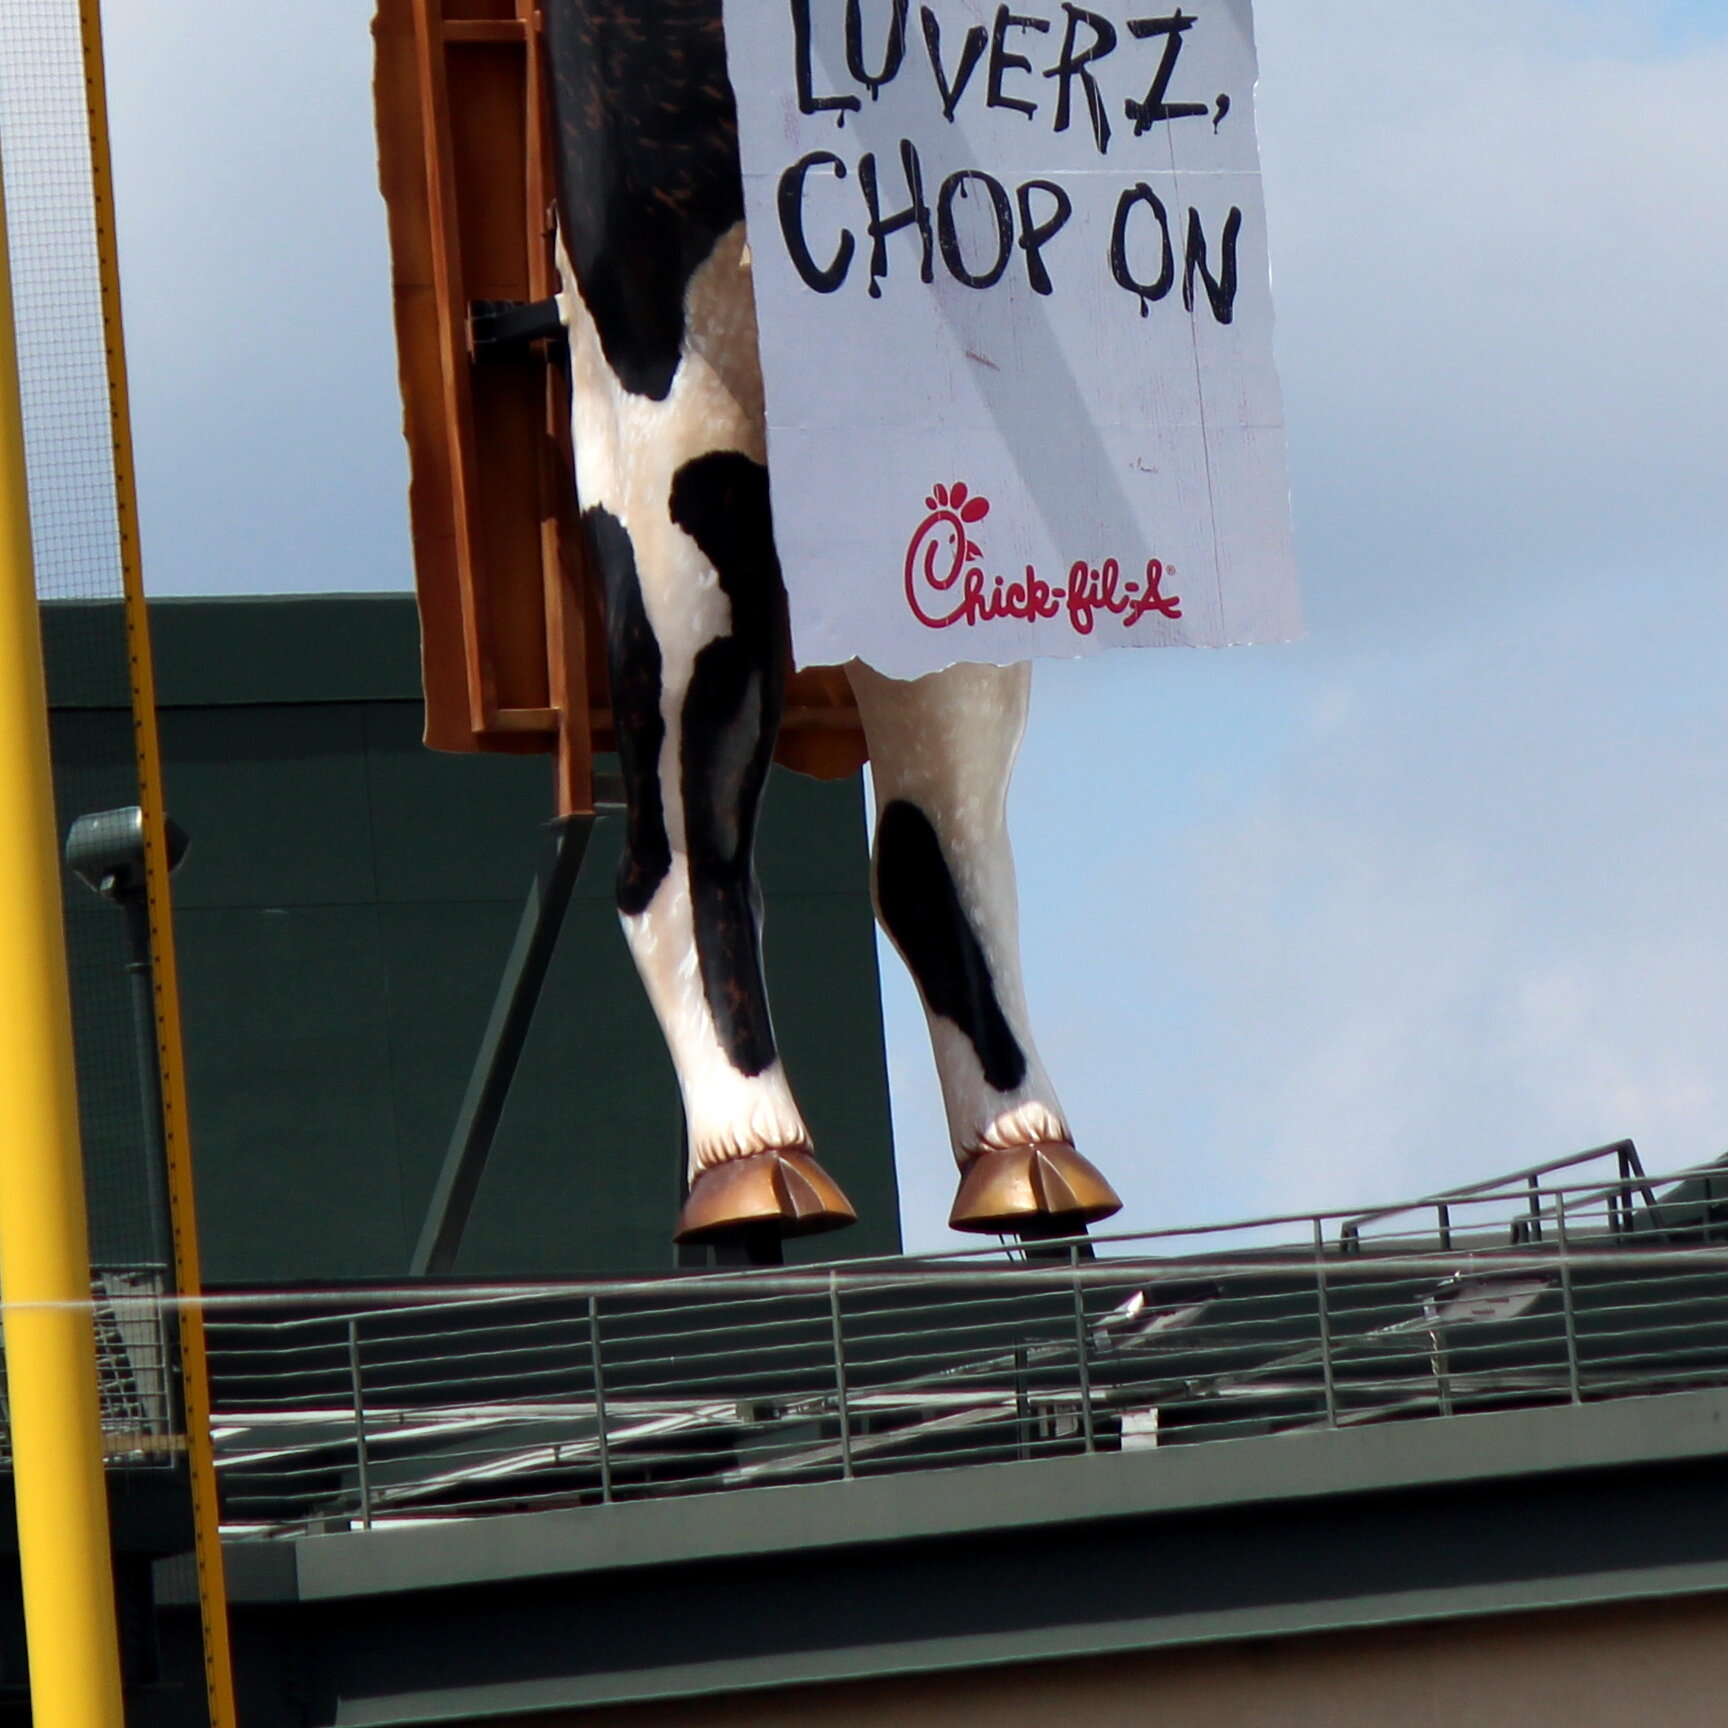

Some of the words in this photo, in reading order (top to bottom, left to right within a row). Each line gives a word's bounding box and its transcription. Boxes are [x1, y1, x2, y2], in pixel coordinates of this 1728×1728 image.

[776, 138, 1073, 299] CHOP
[1109, 181, 1243, 326] ON
[904, 509, 1183, 635] Chick-fil-A
